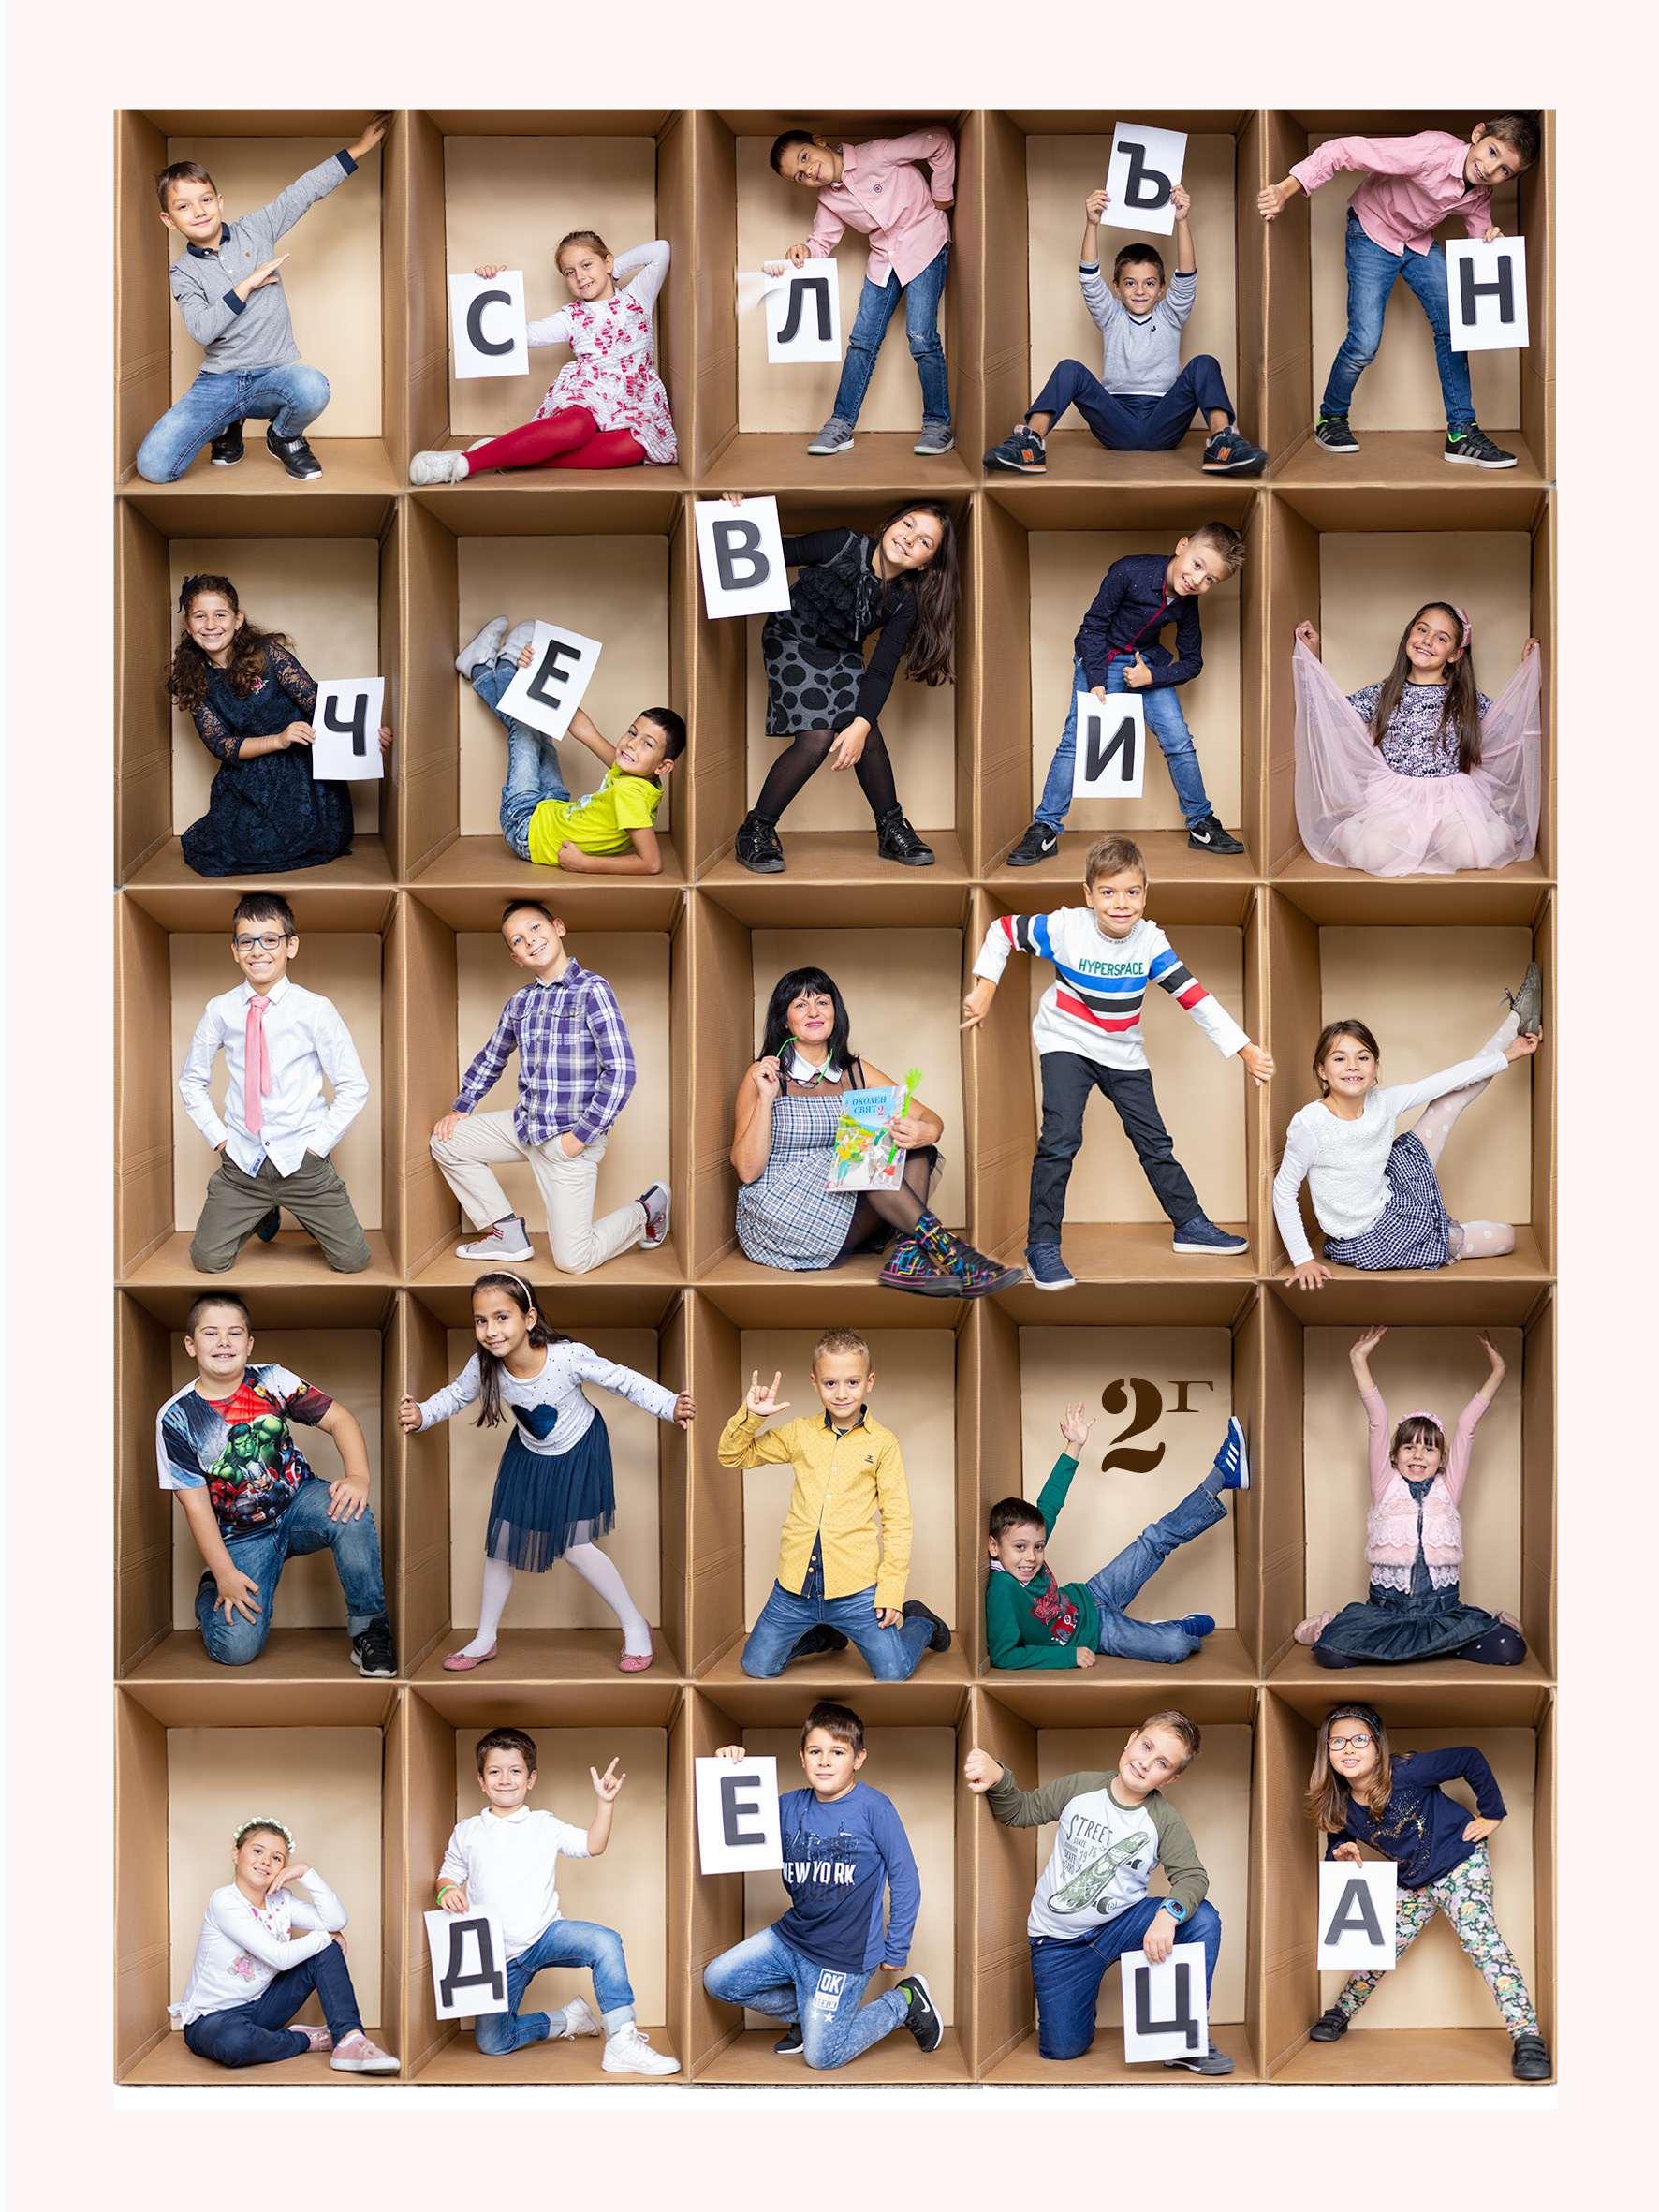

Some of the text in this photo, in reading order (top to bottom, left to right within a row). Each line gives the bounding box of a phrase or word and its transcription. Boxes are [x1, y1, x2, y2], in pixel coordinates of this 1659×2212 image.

[1117, 140, 1176, 209] Ъ
[777, 278, 832, 344] Л
[1459, 255, 1515, 326] Н
[1021, 449, 1034, 463] N
[1217, 447, 1231, 461] N
[712, 520, 771, 591] В
[527, 640, 581, 710] Е
[324, 693, 368, 755] Ч
[1084, 715, 1136, 782] И
[1078, 957, 1144, 977] HYPERSPACE
[852, 1097, 887, 1106] ОКОЛЕН
[854, 1105, 876, 1114] СВЯТ
[1066, 1814, 1113, 1845] STREET
[1073, 1837, 1087, 1848] SINCE
[1324, 1879, 1385, 1946] А
[440, 1917, 504, 2008] Д
[820, 1973, 844, 1994] OK
[1135, 1963, 1199, 2050] Ц
